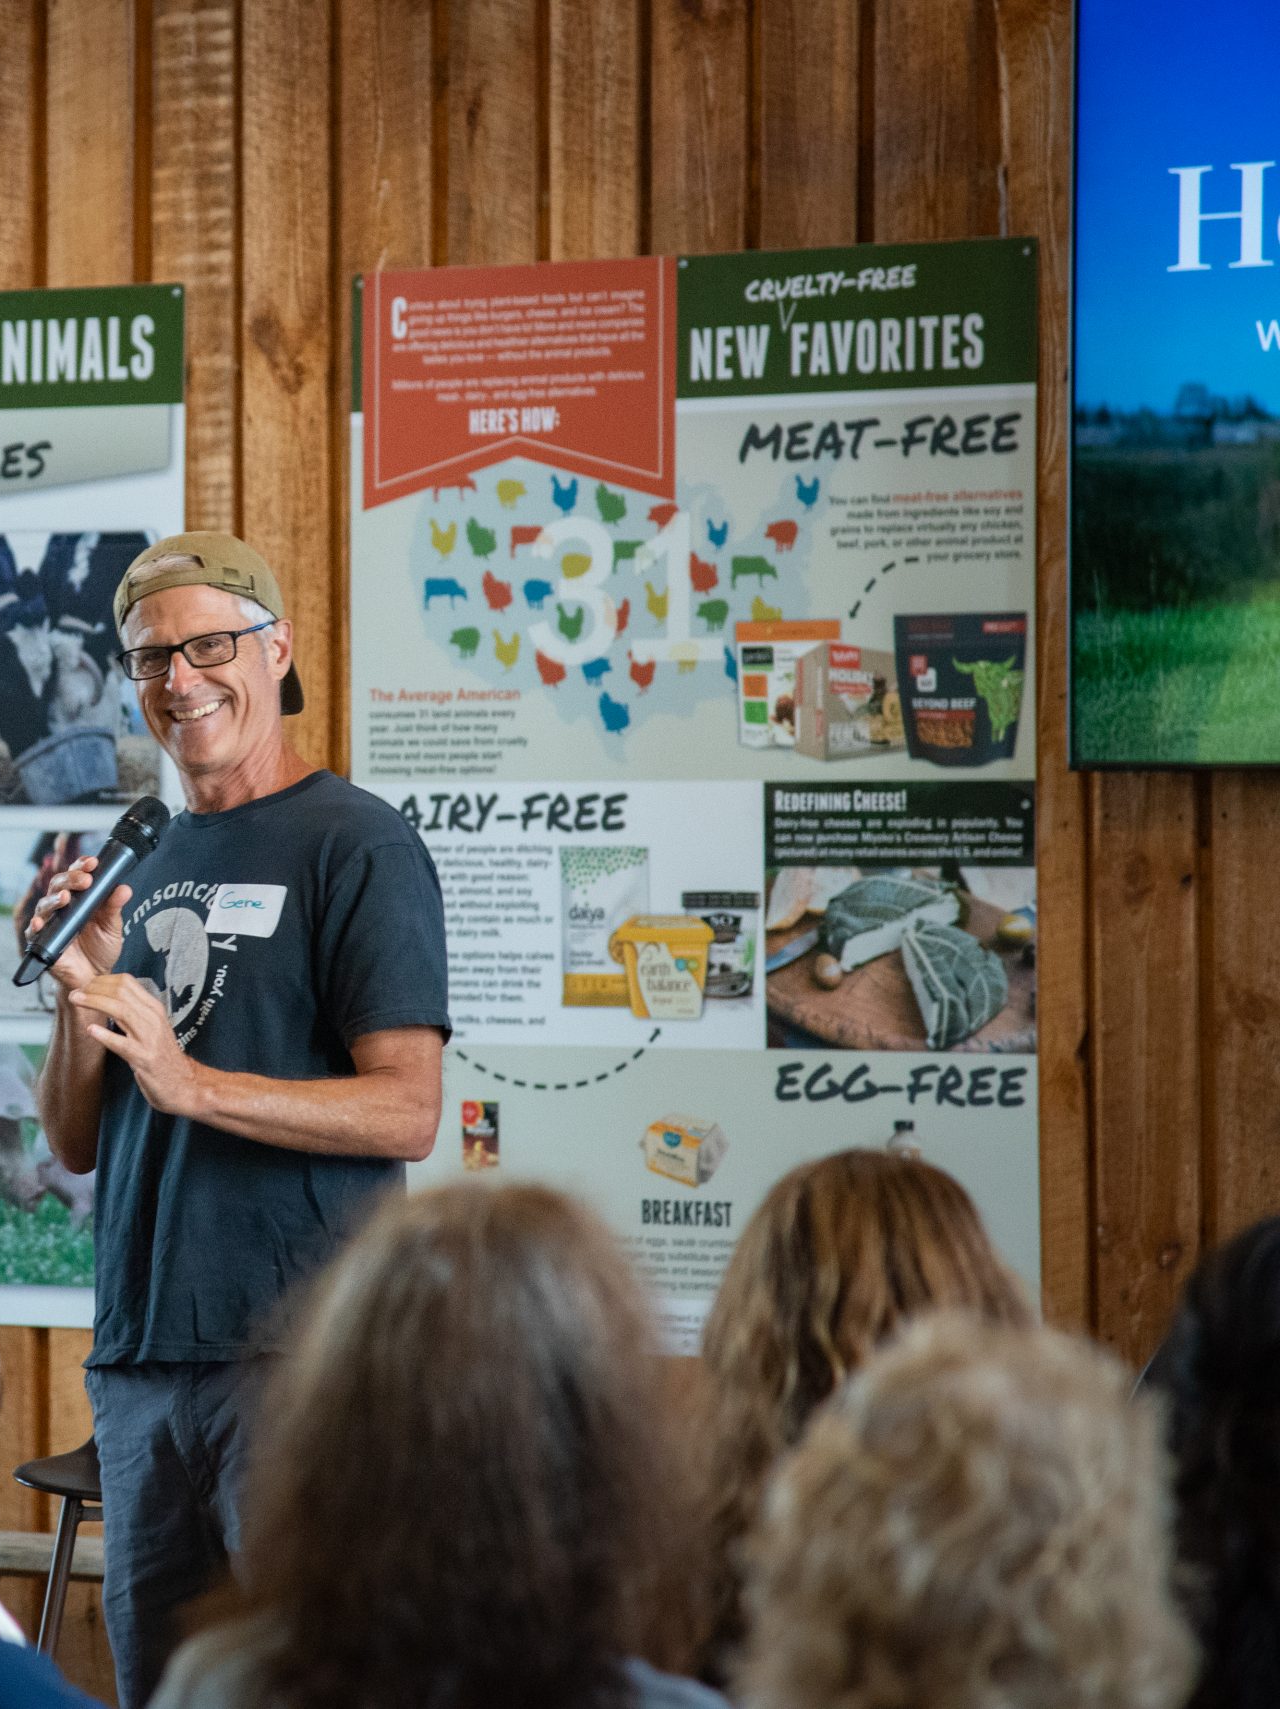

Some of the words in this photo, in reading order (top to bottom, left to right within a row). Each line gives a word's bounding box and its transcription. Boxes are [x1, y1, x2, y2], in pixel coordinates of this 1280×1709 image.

[744, 264, 918, 302] CRUELTY-FREE
[690, 325, 770, 382] NEW
[790, 313, 985, 377] FAVORITES
[468, 408, 519, 434] HERE'S
[521, 405, 561, 432] HOW:
[738, 412, 1022, 465] MEAT-FREE
[527, 510, 724, 667] 31
[370, 688, 394, 702] The
[398, 688, 453, 704] Average
[458, 687, 522, 702] American
[400, 792, 629, 833] AIRY-FREE
[773, 789, 852, 812] REDEFINING
[853, 788, 907, 812] CHEESE!
[219, 891, 267, 910] Gene
[568, 904, 605, 923] daiya
[177, 1026, 198, 1051] gins
[196, 998, 216, 1026] with
[210, 964, 229, 997] you.
[774, 1062, 1028, 1107] EGG-FREE
[642, 1198, 733, 1228] BREAKFAST
